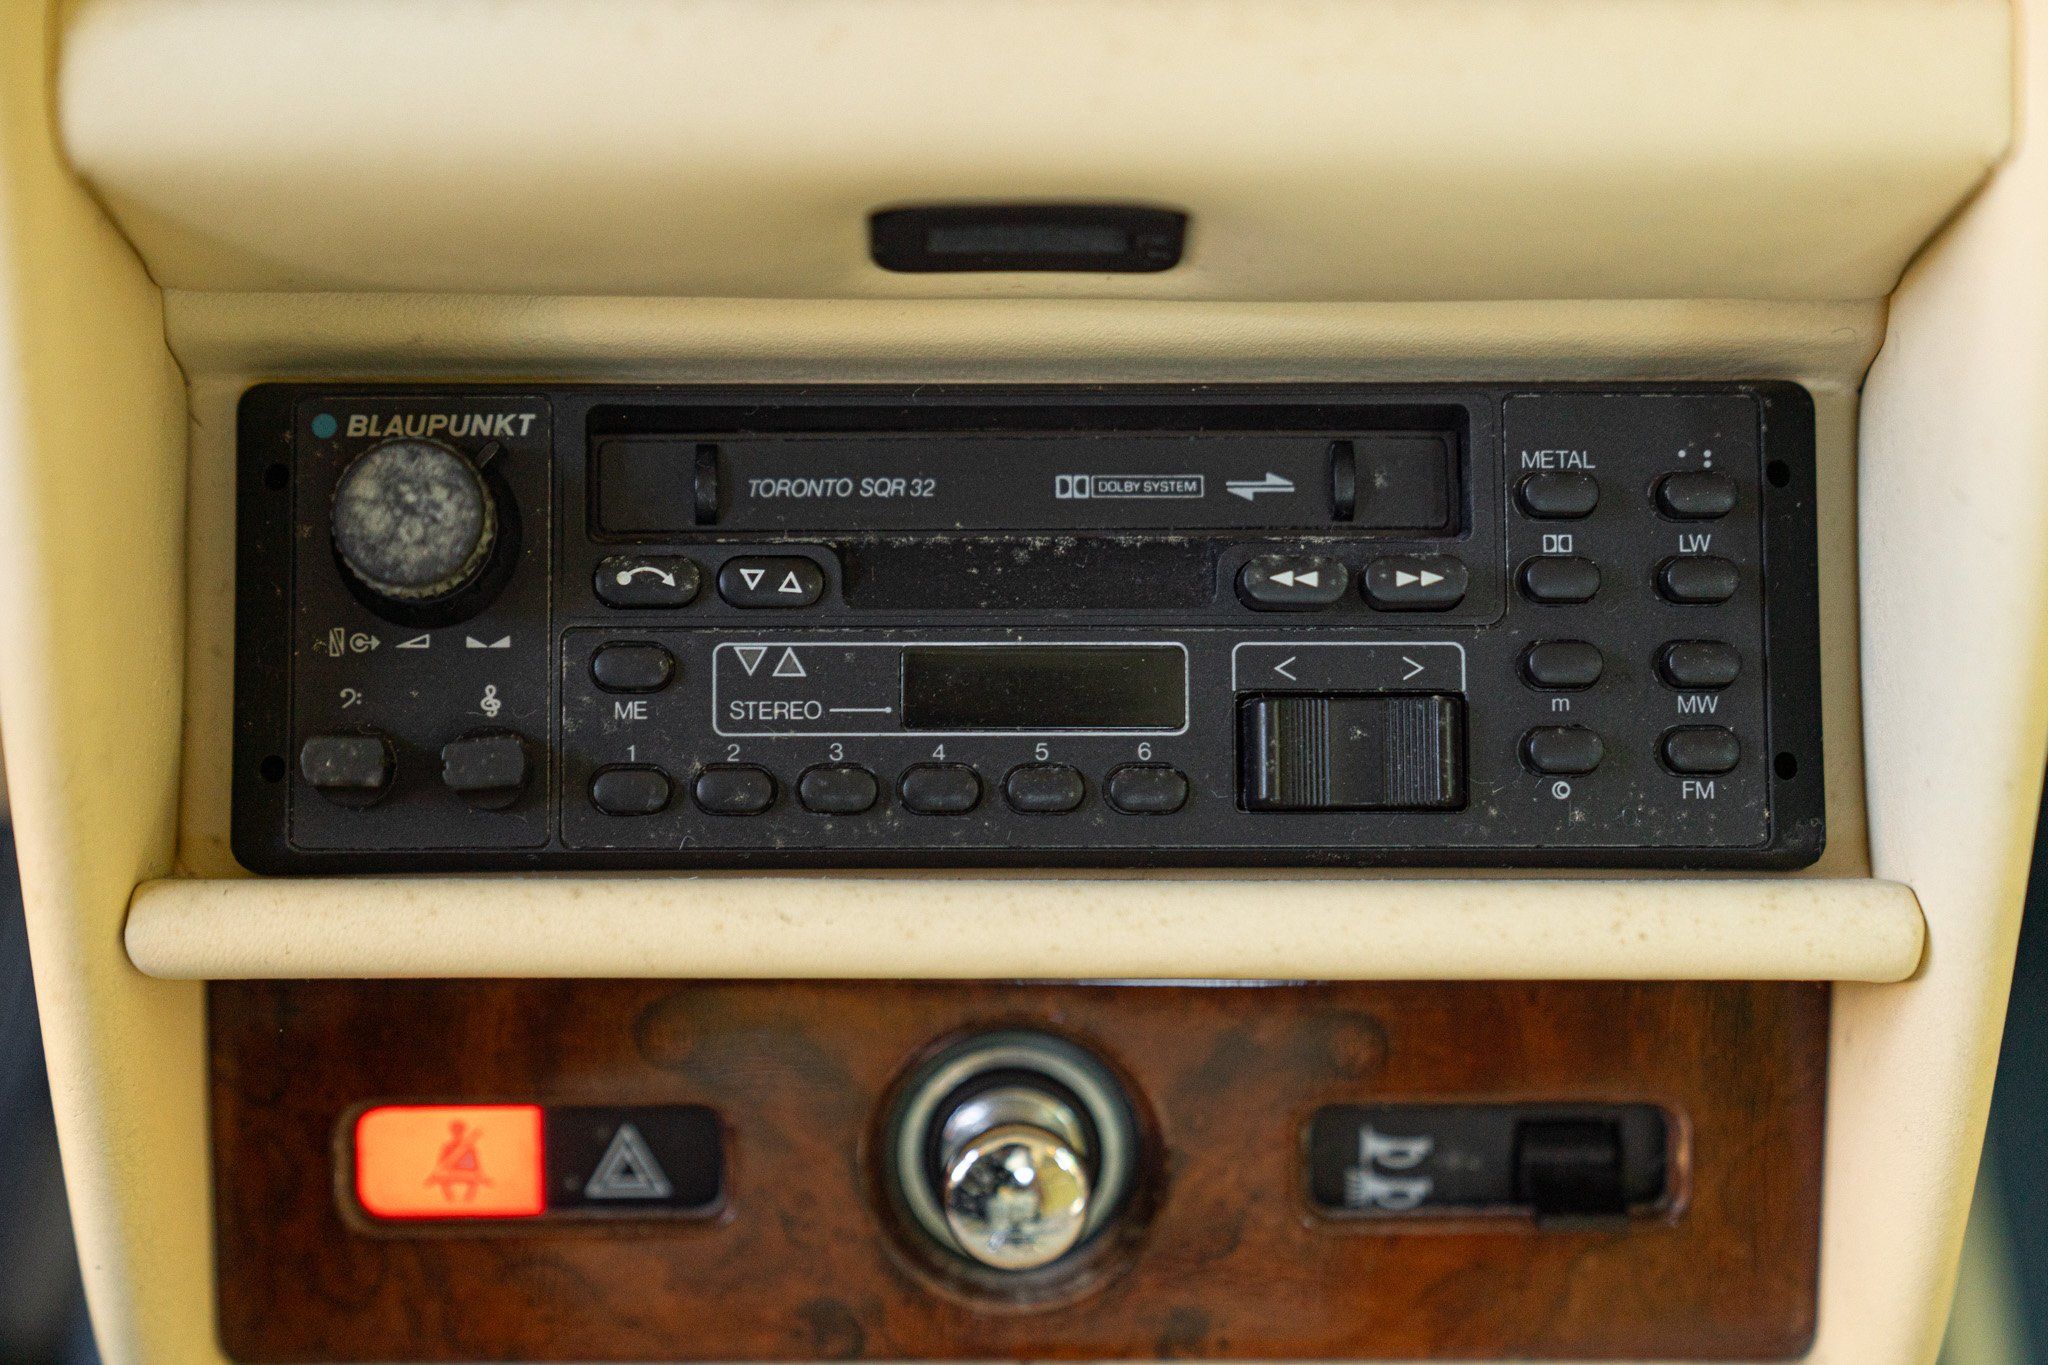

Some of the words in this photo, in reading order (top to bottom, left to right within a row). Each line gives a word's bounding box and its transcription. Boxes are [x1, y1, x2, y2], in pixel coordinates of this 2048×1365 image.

[346, 413, 537, 438] BLAUPUNKT
[1521, 449, 1596, 469] METAL
[748, 477, 854, 499] TORONTO
[859, 477, 906, 499] SQR
[909, 478, 937, 498] 32
[1097, 480, 1140, 493] DOLBY
[1143, 480, 1197, 493] SYSTEM
[1678, 533, 1712, 553] LW
[614, 700, 648, 721] ME
[729, 700, 823, 721] STEREO
[1551, 697, 1571, 712] m
[1677, 694, 1719, 714] MW
[627, 744, 636, 762] 1
[726, 743, 741, 763] 2
[828, 742, 844, 763] 3
[932, 743, 947, 761] 4
[1035, 742, 1050, 762] 5
[1137, 741, 1152, 762] 6
[1682, 780, 1715, 800] FM
